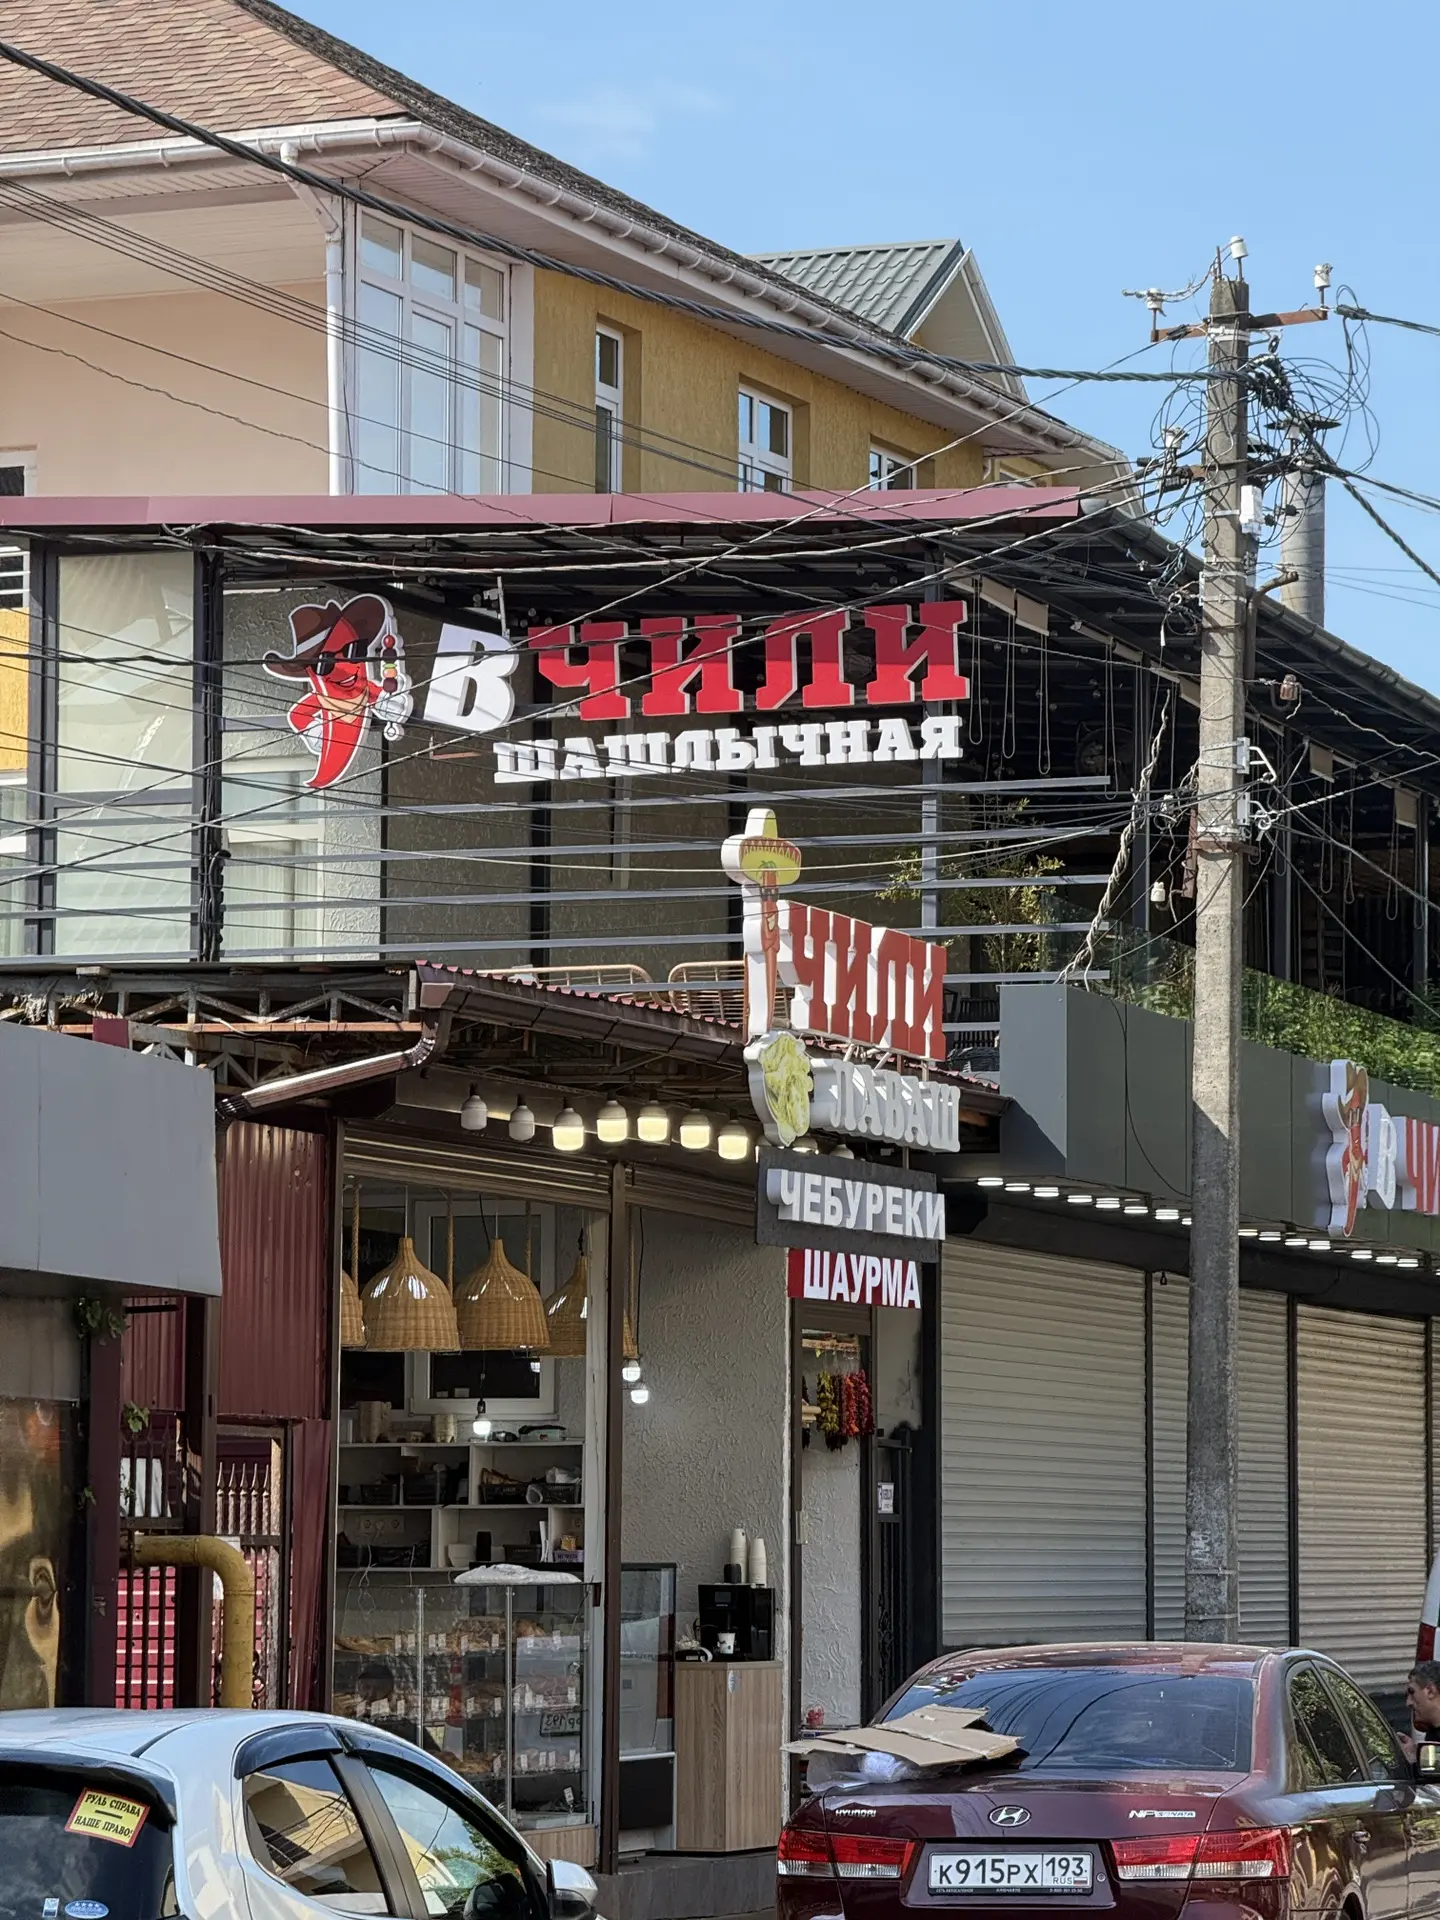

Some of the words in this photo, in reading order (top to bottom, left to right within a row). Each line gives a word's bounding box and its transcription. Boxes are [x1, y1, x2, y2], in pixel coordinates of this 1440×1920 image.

[423, 622, 519, 730] В
[527, 600, 969, 721] ЧИЛИ
[493, 715, 963, 784] ШАШЛЫЧНАЯ
[786, 901, 947, 1062] ЧИЛИ
[829, 1060, 961, 1153] ЛАВАШ
[777, 1168, 946, 1241] ЧЕБУРЕКИ
[803, 1249, 922, 1309] ШАУРМА
[74, 1815, 102, 1829] НАШЕ
[85, 1793, 107, 1807] РУЛЬ
[109, 1799, 141, 1817] СПРАВА
[835, 1809, 877, 1818] HYUNDAI
[938, 1858, 1039, 1885] К915РХ
[1045, 1856, 1085, 1877] 193
[1052, 1876, 1073, 1885] RUS
